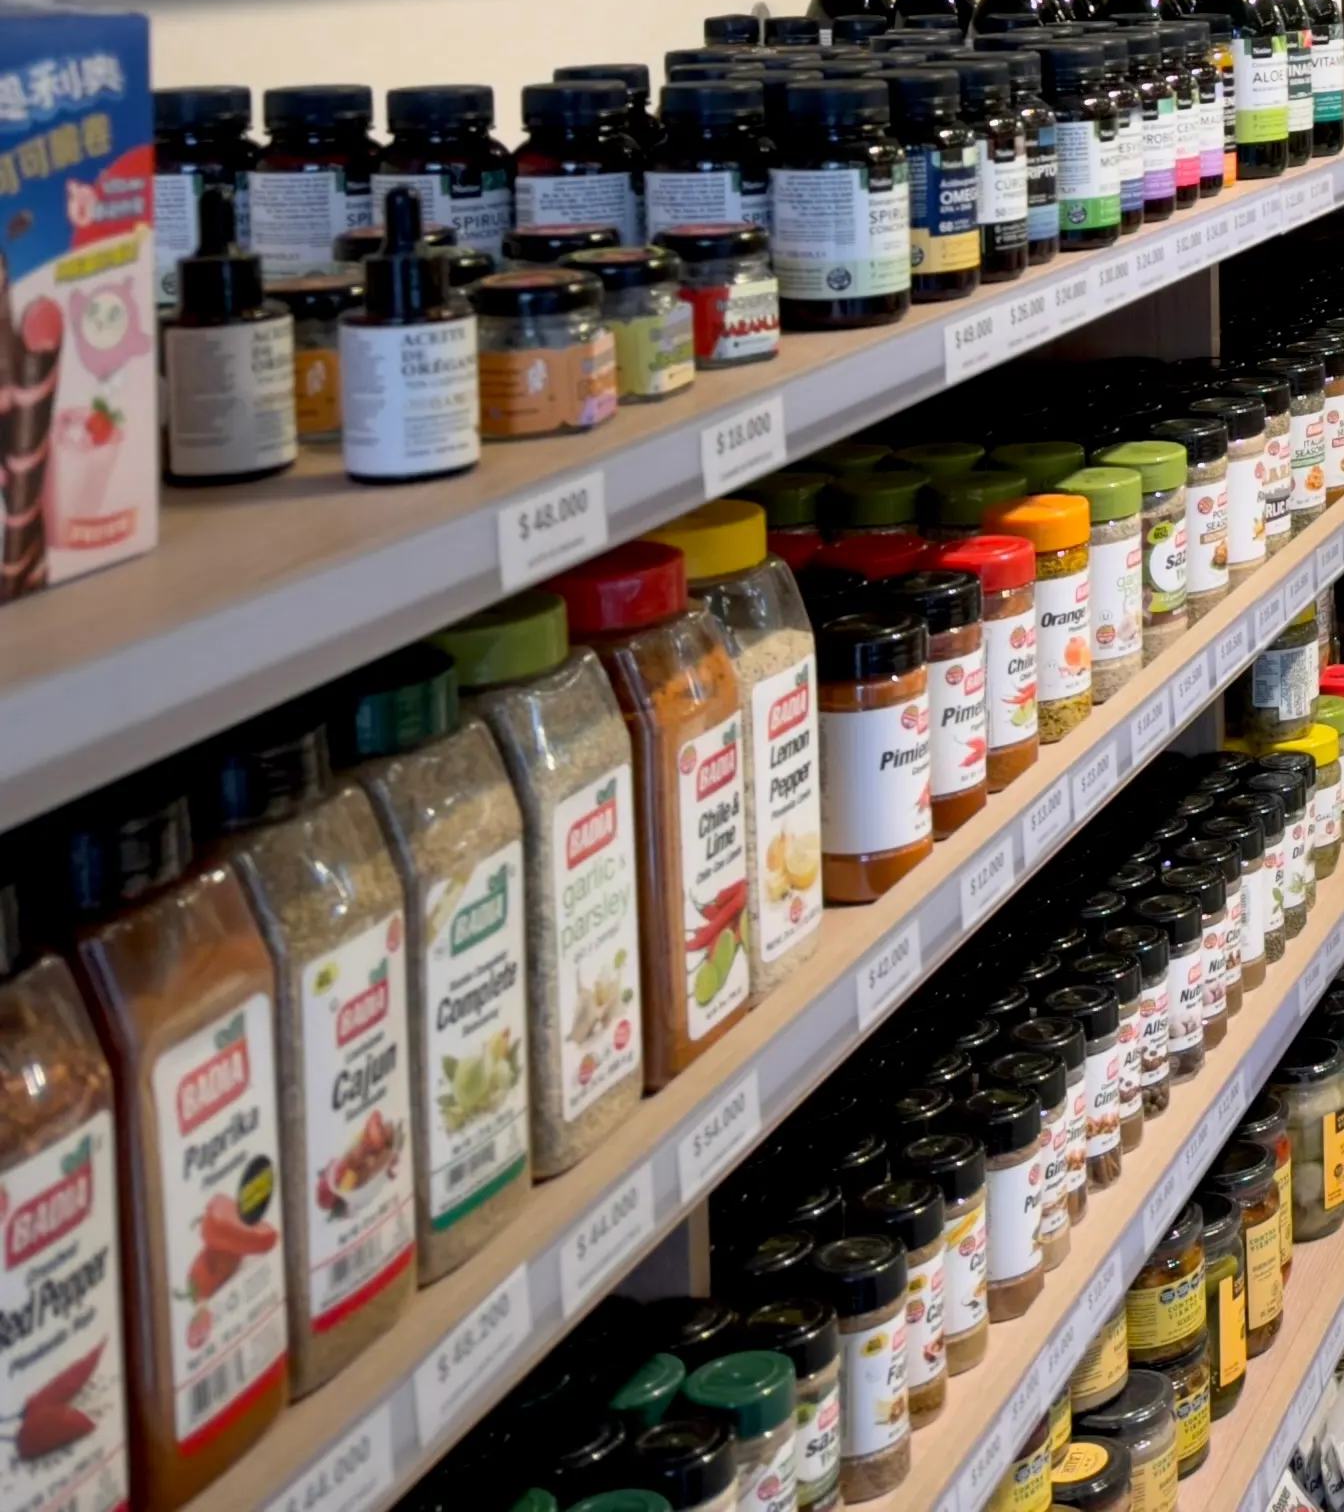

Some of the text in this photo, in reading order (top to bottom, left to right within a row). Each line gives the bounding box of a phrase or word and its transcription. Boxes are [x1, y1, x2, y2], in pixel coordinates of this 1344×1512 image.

[1252, 69, 1285, 84] ALOE
[1040, 607, 1087, 630] Orange
[769, 728, 811, 770] Lemon
[769, 760, 812, 805] Pepper
[697, 799, 730, 841] Chile
[705, 822, 737, 862] Lime
[560, 853, 616, 919] garlic
[559, 882, 633, 959] parsley
[435, 960, 519, 1032] Complete
[331, 1042, 398, 1113] Cajun
[182, 1104, 260, 1182] Paprika
